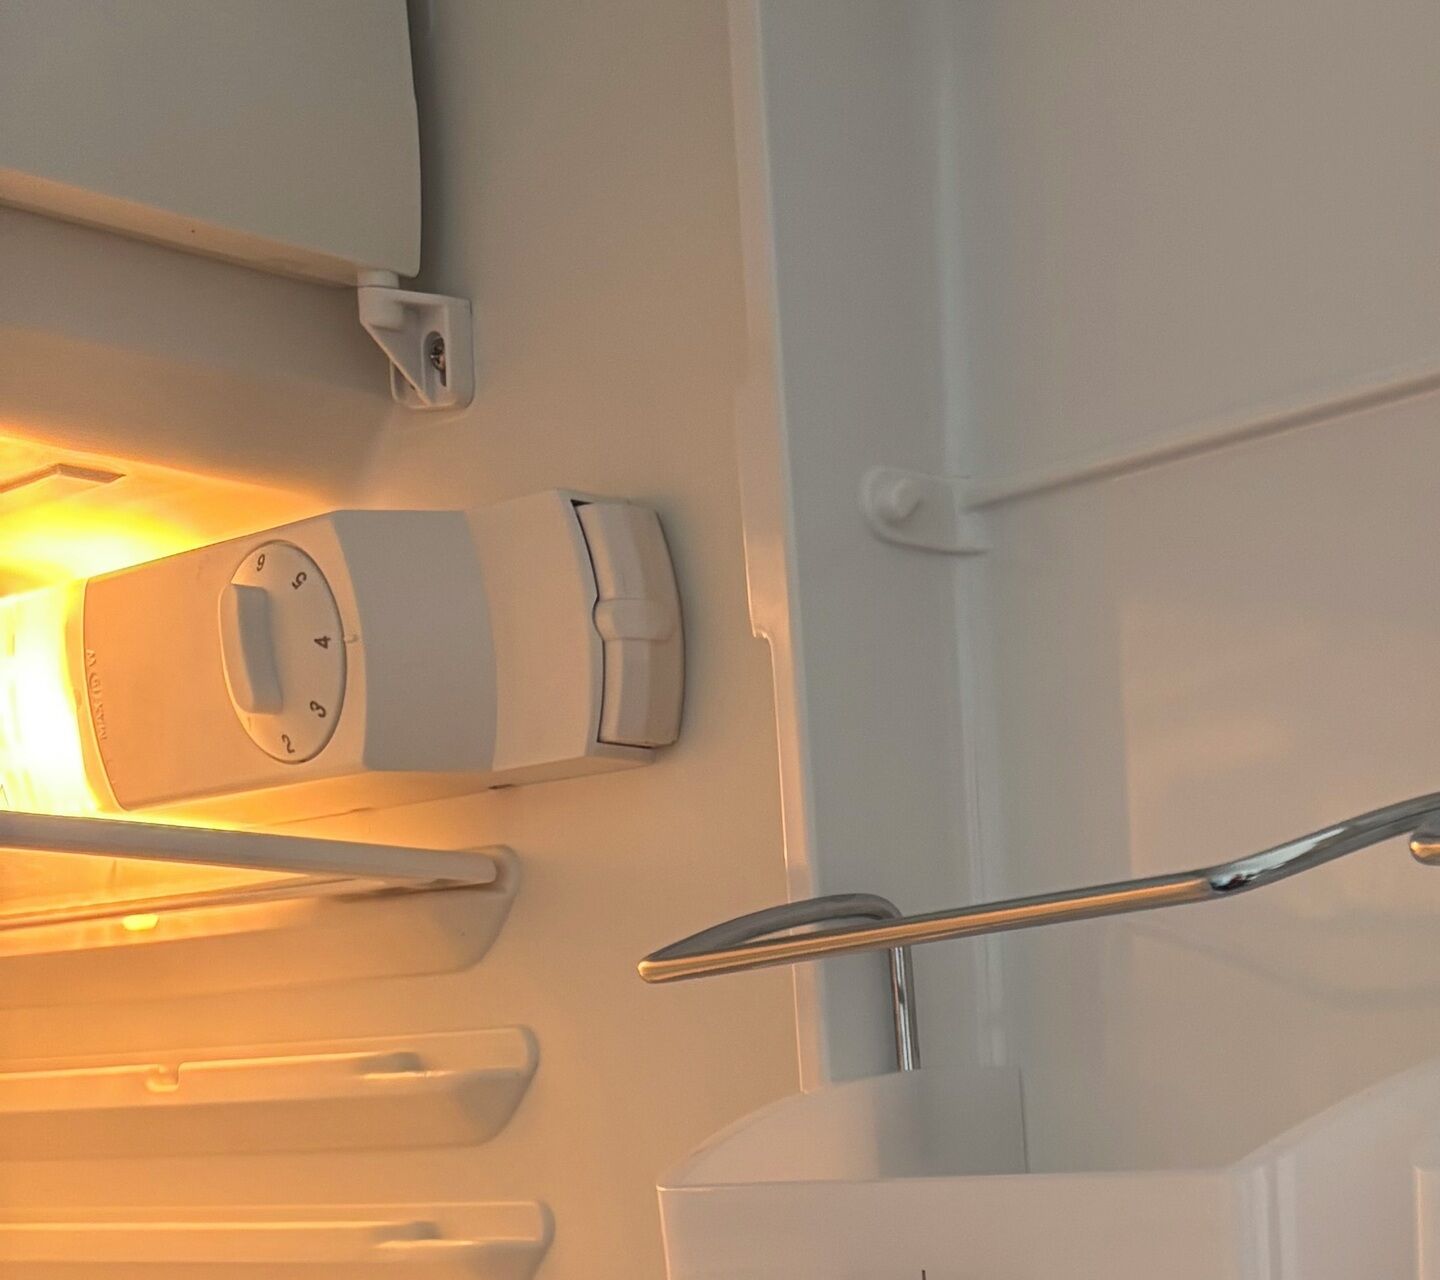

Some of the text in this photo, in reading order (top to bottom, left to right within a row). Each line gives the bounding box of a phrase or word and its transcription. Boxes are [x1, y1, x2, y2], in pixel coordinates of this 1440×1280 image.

[291, 571, 307, 590] 5
[314, 635, 332, 649] 4
[309, 700, 327, 718] 3
[281, 733, 295, 753] 2
